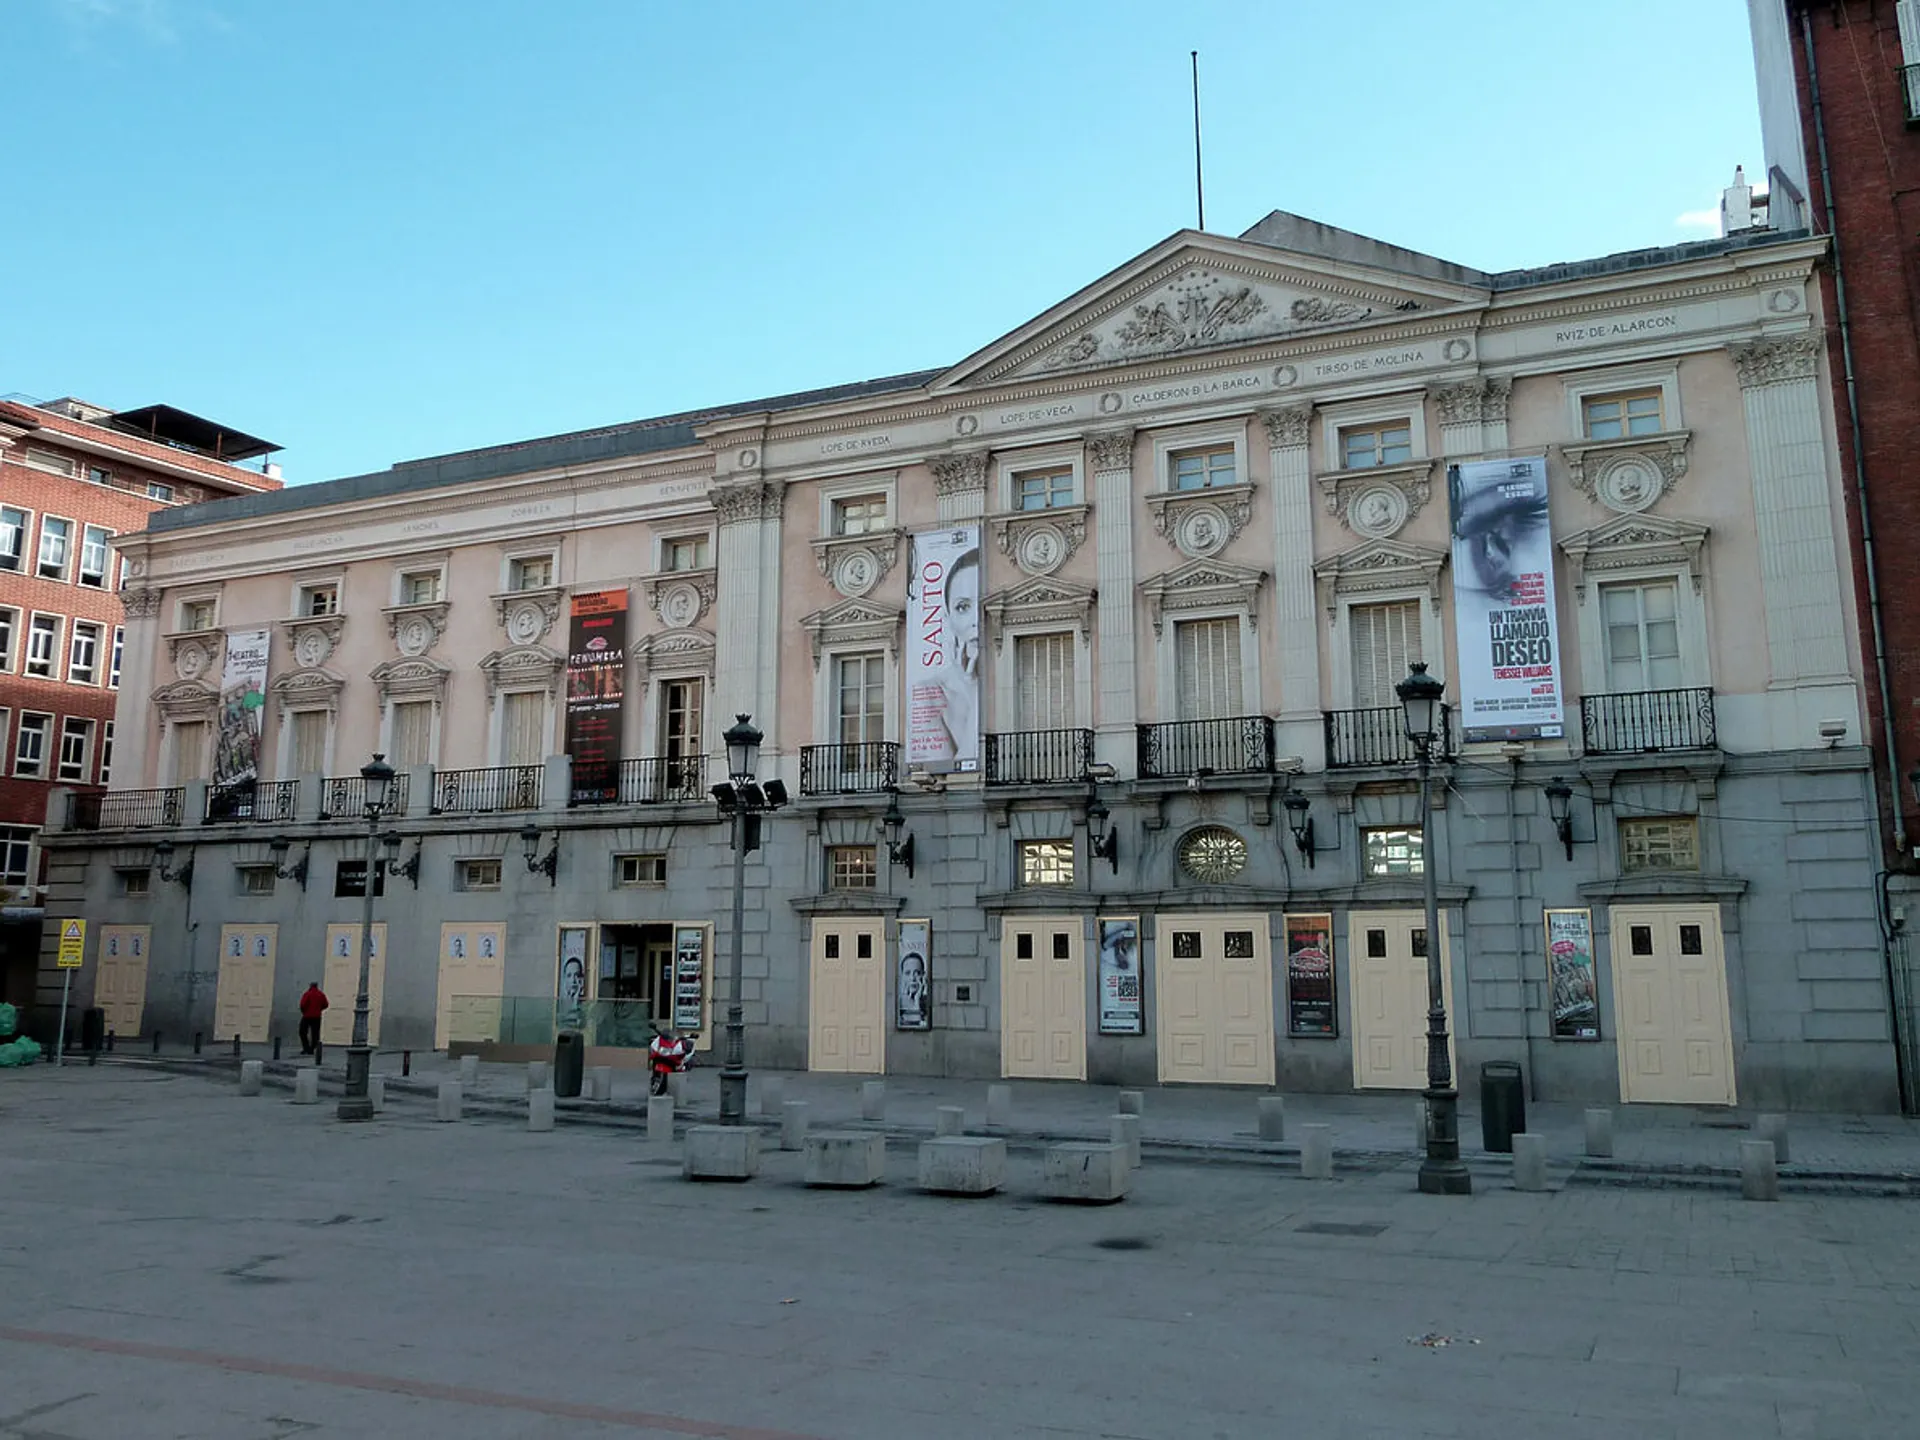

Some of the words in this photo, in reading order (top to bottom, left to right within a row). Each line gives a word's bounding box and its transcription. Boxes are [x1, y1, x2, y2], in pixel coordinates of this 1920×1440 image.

[1589, 326, 1606, 338] DE
[1611, 316, 1676, 335] ALARCON
[1315, 363, 1350, 376] TIRSO
[1354, 360, 1368, 371] DE
[1374, 351, 1424, 367] MOLINA
[1133, 387, 1191, 404] CALDERON
[1222, 376, 1261, 391] BARCA
[1001, 412, 1025, 424] LOPE
[1029, 410, 1041, 421] DE
[1046, 405, 1075, 418] VEGA
[922, 561, 944, 667] SANTO
[1489, 610, 1503, 624] UN
[1504, 606, 1547, 622] TRANVÍA
[1490, 620, 1550, 640] LLAMADO
[1491, 638, 1552, 667] DESEO
